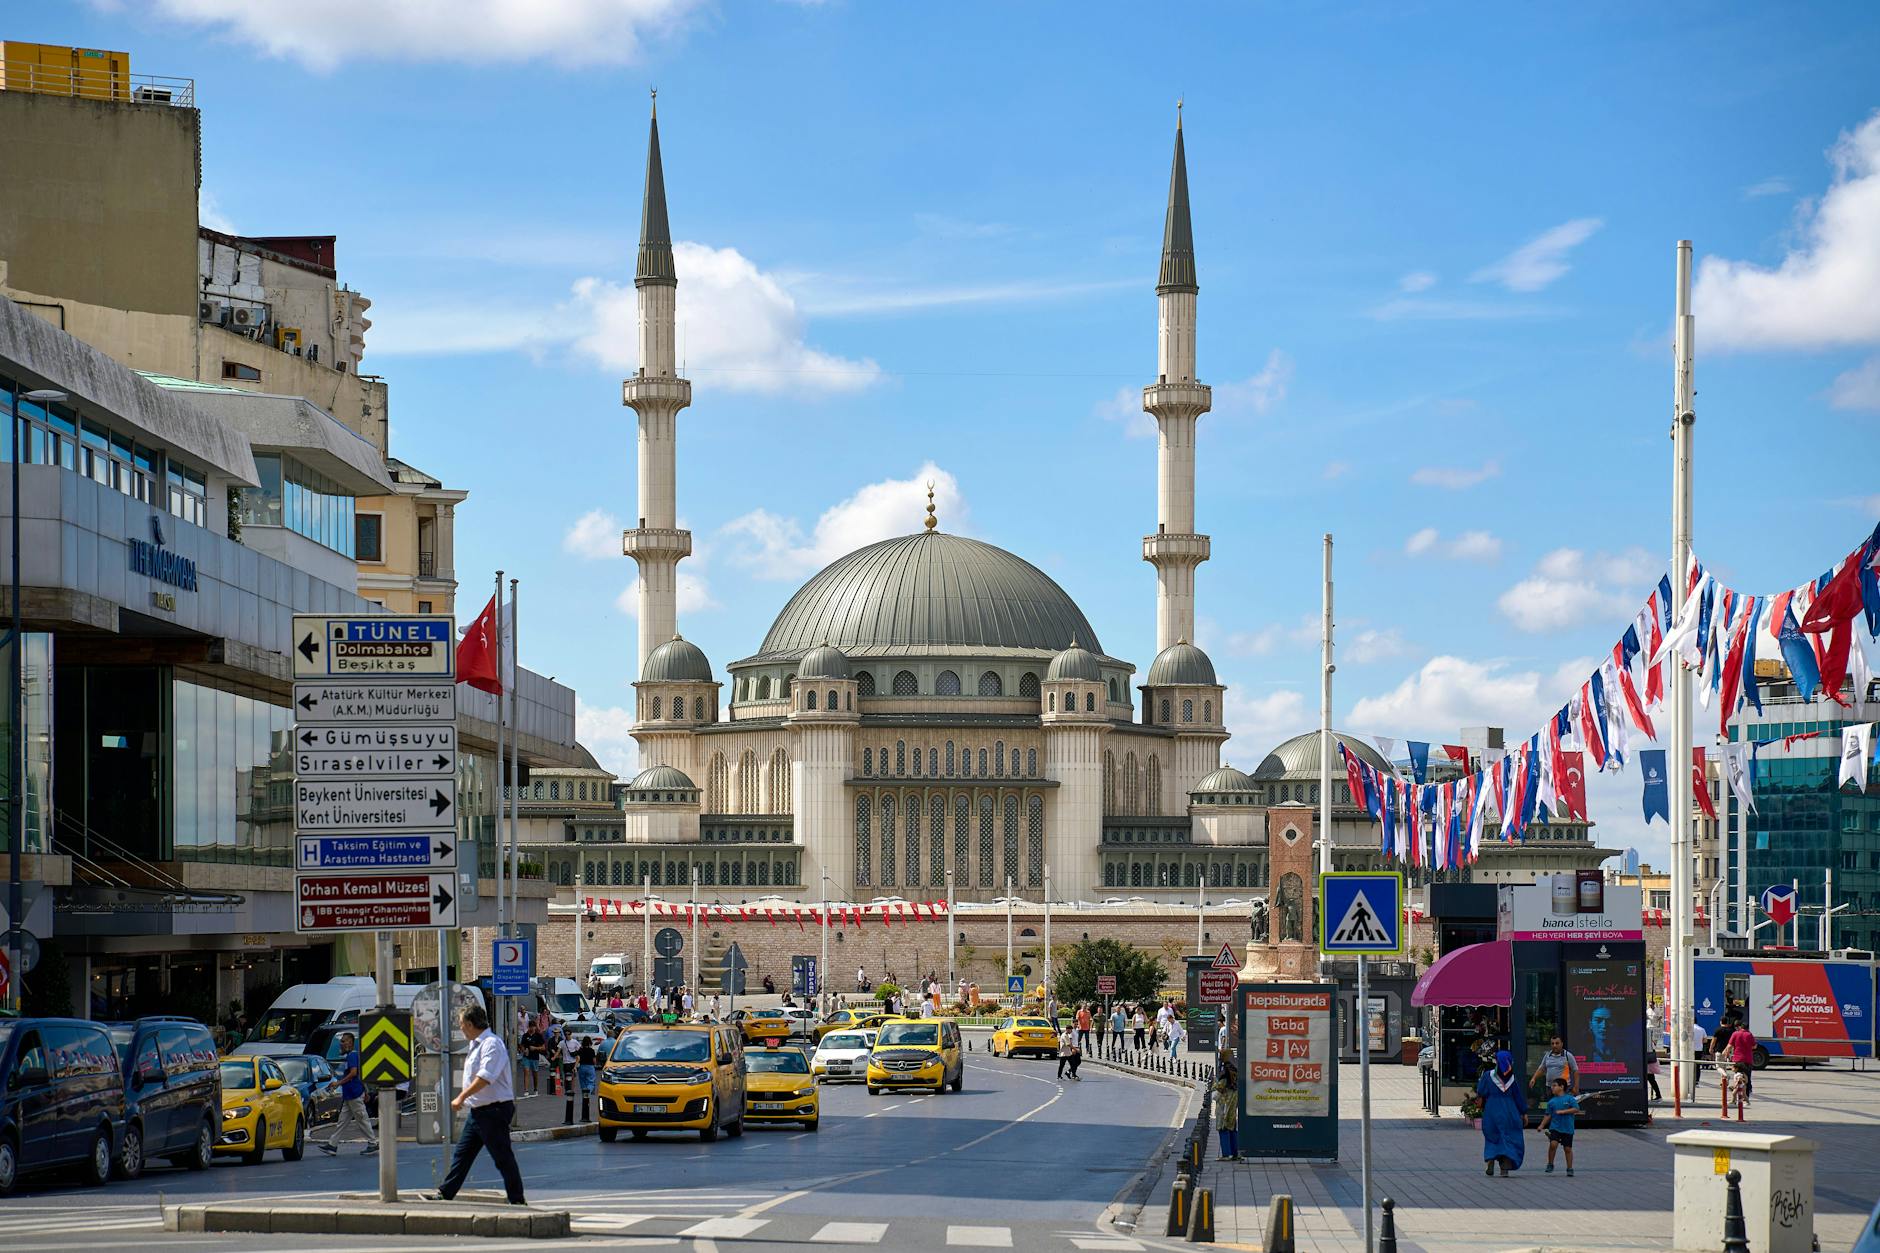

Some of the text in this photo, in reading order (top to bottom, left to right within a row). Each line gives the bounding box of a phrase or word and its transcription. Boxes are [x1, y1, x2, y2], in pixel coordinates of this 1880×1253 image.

[152, 544, 198, 592] MARMARA
[355, 623, 437, 639] TÜNEL
[338, 644, 429, 656] Dolmabahçe
[338, 659, 415, 671] Beşiktaş
[322, 689, 451, 700] Atatürk Kültür Merkezi
[333, 704, 439, 718] (A.K.M.) Müdürlüğü
[326, 730, 449, 748] Gümüşsuyu
[300, 754, 423, 771] Sıraselviler
[300, 783, 428, 805] Beykent Üniversitesi
[301, 806, 406, 825] Kent Üniversitesi
[332, 840, 422, 852] Taksim Eğitim ve
[304, 845, 317, 862] H
[324, 853, 430, 865] Araştırma Hastanesi
[302, 880, 428, 896] Orhan Kemal Müzesi
[335, 904, 370, 916] Cihangir
[373, 903, 429, 914] Cihannüması
[336, 915, 410, 926] Sosyal Tesisleri
[1542, 915, 1613, 928] bianca stella
[1584, 931, 1601, 940] ŞEYİ
[1249, 995, 1326, 1008] hepsiburada
[1792, 994, 1827, 1005] ÇÖZÜM
[1792, 1005, 1834, 1014] NOKTASI
[1272, 1019, 1304, 1031] Baba
[1271, 1042, 1308, 1056] 3 Ay
[1254, 1065, 1321, 1080] Sonra Öde
